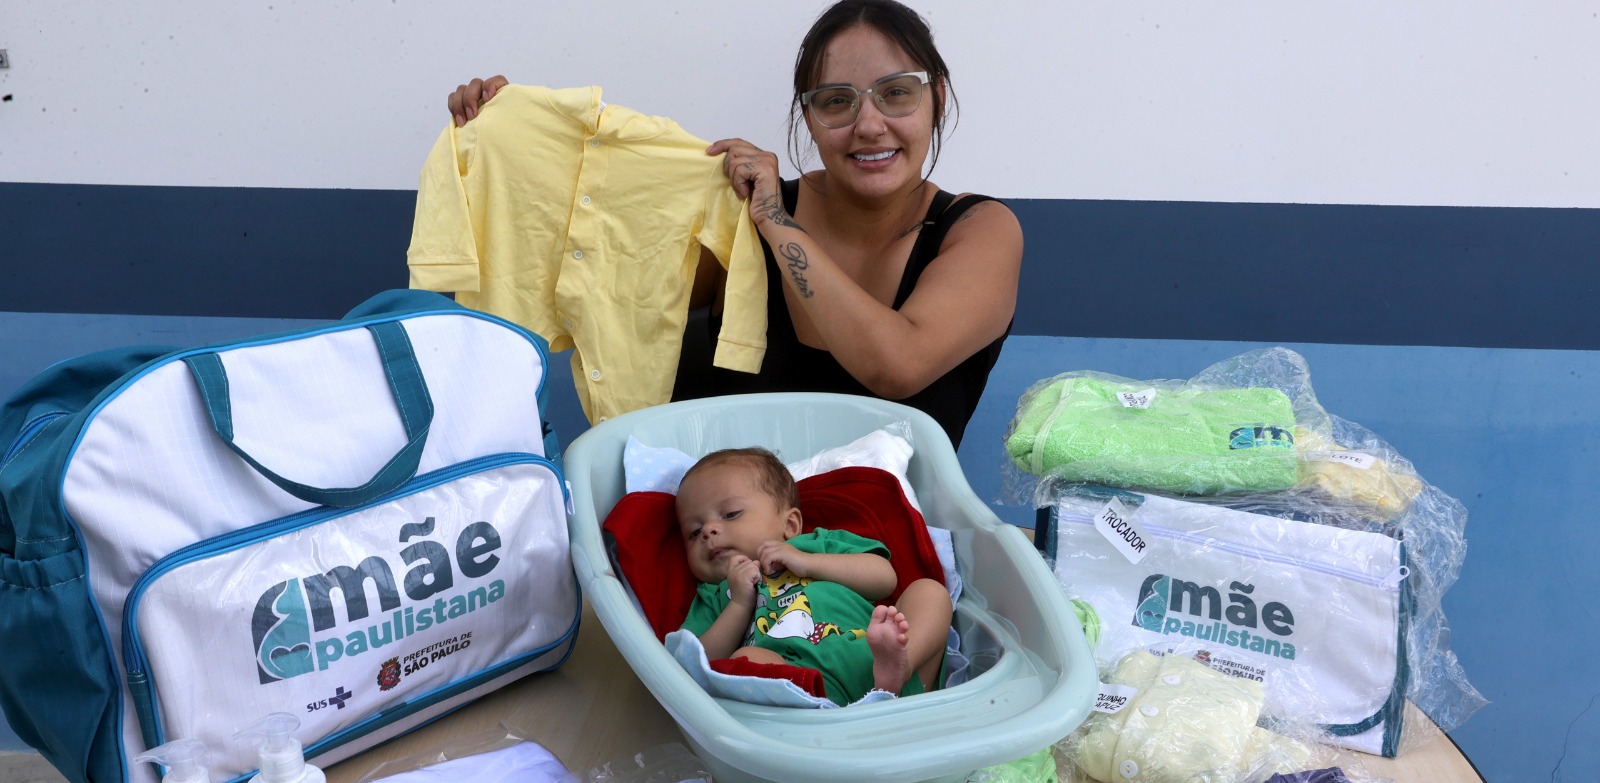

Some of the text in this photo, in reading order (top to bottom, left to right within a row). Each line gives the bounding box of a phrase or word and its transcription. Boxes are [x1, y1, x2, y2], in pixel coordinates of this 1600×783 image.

[1102, 507, 1146, 553] TROCADOR
[303, 516, 502, 633] mãe
[315, 578, 506, 671] paulistana
[1170, 578, 1295, 636] mãe
[403, 631, 473, 664] PREFEITURA DE
[404, 640, 471, 677] SÃO PAULO
[1164, 616, 1296, 661] paulistana
[1213, 657, 1266, 676] PREFEITURA DE
[306, 699, 328, 713] SUS
